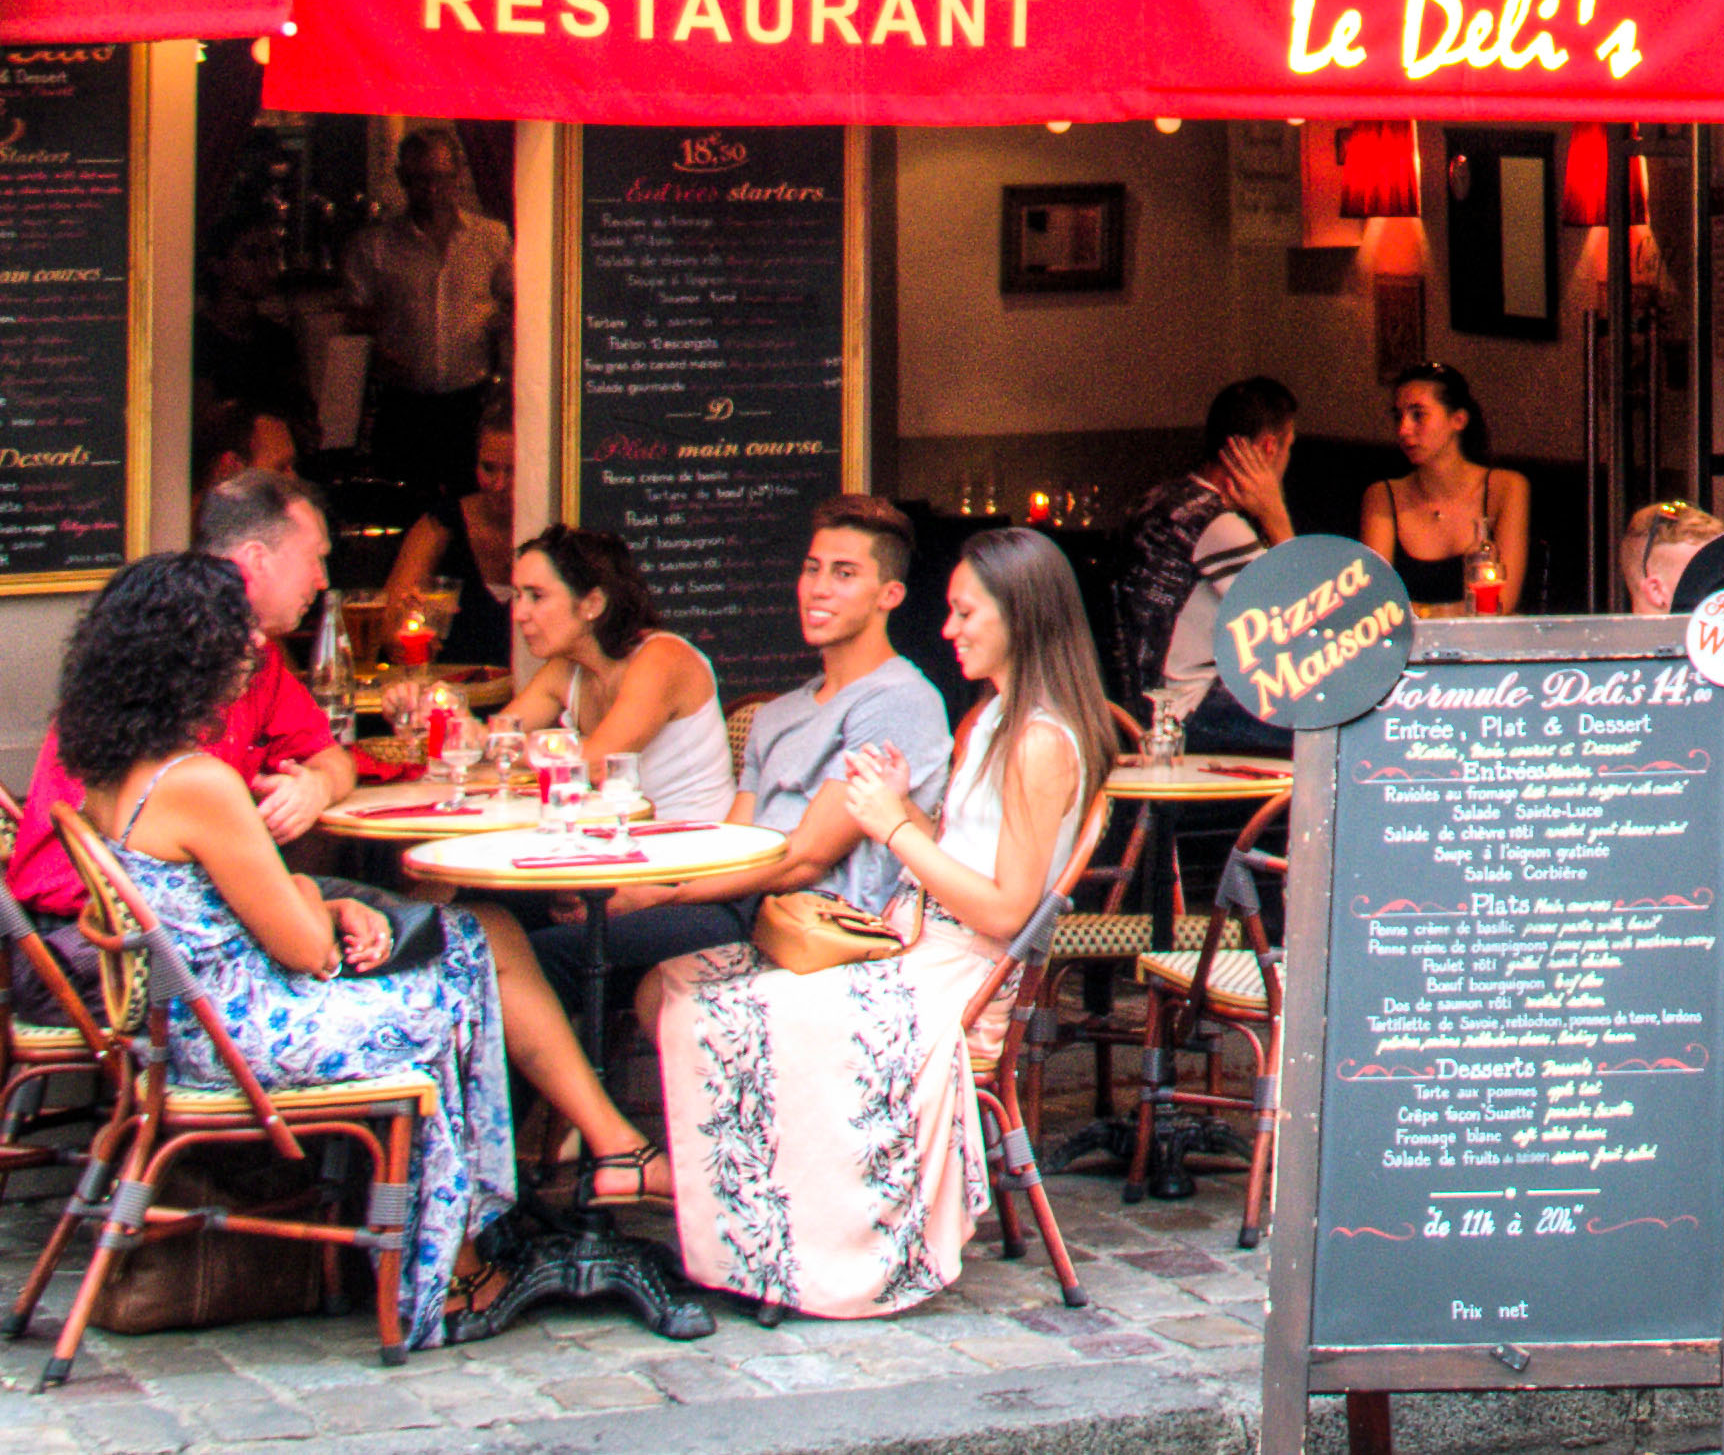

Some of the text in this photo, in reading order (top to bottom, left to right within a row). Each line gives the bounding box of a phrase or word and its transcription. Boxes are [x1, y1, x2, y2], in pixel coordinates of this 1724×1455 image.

[678, 438, 739, 458] main
[746, 439, 823, 456] course
[1226, 558, 1371, 673] Pizza
[1250, 601, 1404, 721] Maison
[1376, 669, 1533, 711] Formule
[1541, 668, 1646, 710] Deli's
[1481, 716, 1527, 738] Plat
[1543, 716, 1563, 736] &
[1578, 714, 1653, 736] Dessert
[1462, 760, 1545, 784] Entrées
[1383, 785, 1441, 803] Ravioles
[1452, 802, 1604, 822] Salade Sainte-Luce
[1383, 826, 1430, 844] Salade
[1437, 826, 1456, 842] de
[1464, 864, 1513, 882] Salade
[1470, 892, 1530, 916] Plats
[1368, 919, 1408, 938] Penne
[1456, 920, 1472, 936] de
[1368, 938, 1407, 956] Penne
[1450, 939, 1467, 954] de
[1422, 956, 1465, 975] Poulet
[1469, 976, 1546, 996] bourguignon
[1383, 997, 1411, 1015] Dos
[1415, 997, 1433, 1013] de
[1437, 997, 1483, 1013] saumon
[1438, 1016, 1455, 1032] de
[1613, 1009, 1629, 1026] de
[1435, 1056, 1536, 1080] Desserts
[1413, 1083, 1450, 1100] Tarte
[1456, 1086, 1479, 1100] aux
[1486, 1085, 1538, 1103] pommes
[1395, 1127, 1502, 1150] Fromage blanc
[1382, 1149, 1431, 1168] Salade
[1439, 1149, 1456, 1166] de
[1462, 1148, 1500, 1165] fruits
[1459, 1208, 1497, 1237] 11h
[1506, 1211, 1523, 1237] à
[1451, 1299, 1529, 1320] Prix net
